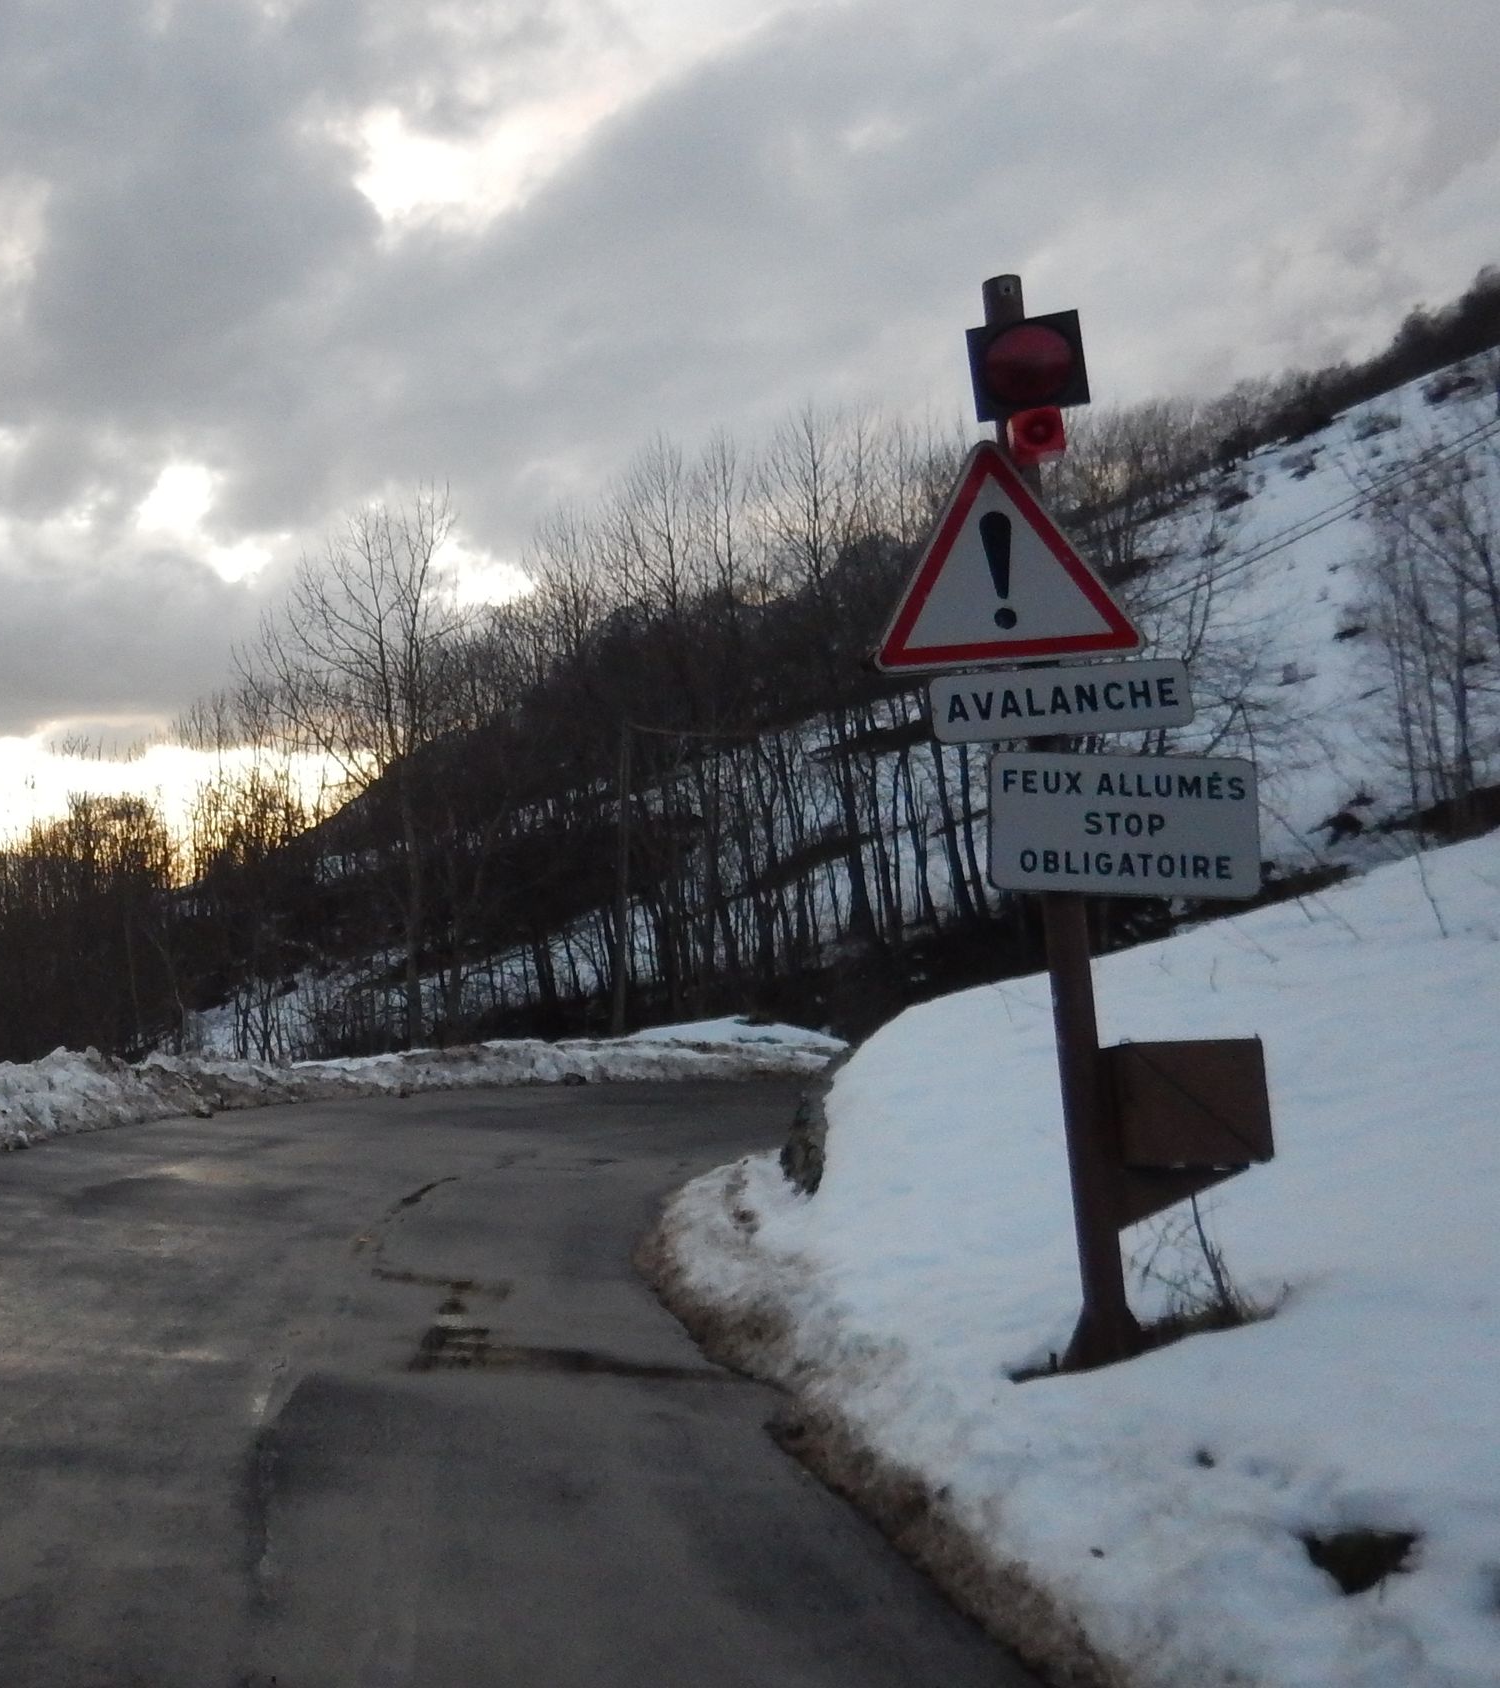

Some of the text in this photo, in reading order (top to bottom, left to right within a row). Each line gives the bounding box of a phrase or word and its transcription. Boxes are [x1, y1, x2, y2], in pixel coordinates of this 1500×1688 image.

[947, 676, 1179, 723] AVALANCHE
[1002, 769, 1246, 801] FEUX ALLUMÉS
[1084, 811, 1166, 837] STOP
[1019, 849, 1232, 880] OBLIGATOIRE
